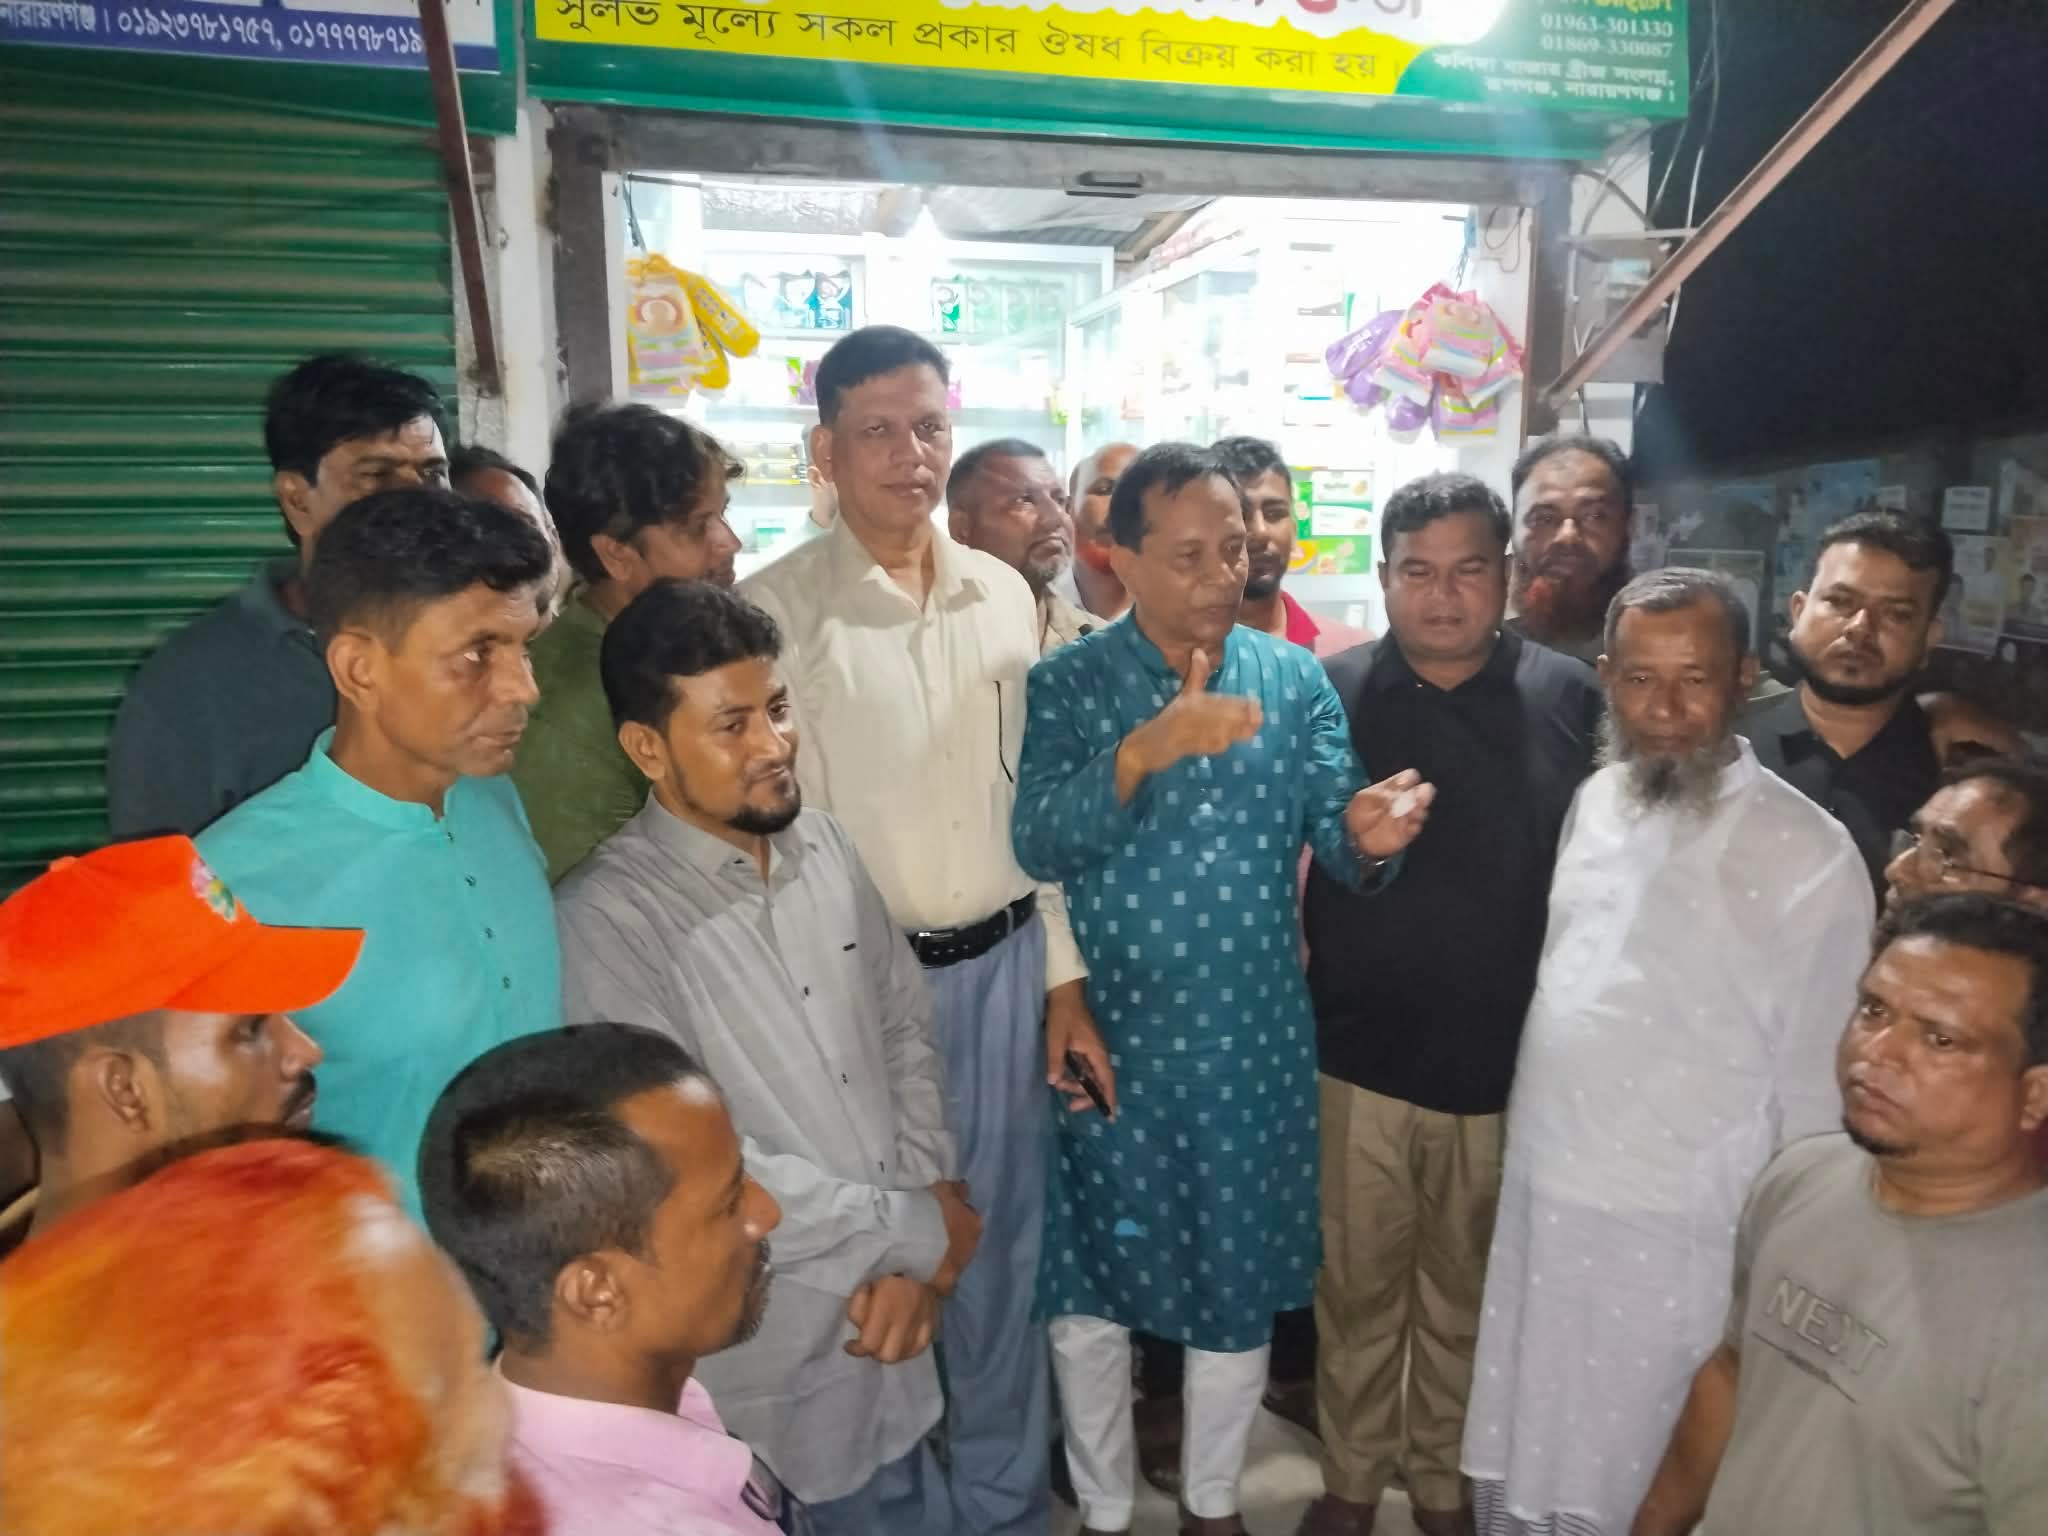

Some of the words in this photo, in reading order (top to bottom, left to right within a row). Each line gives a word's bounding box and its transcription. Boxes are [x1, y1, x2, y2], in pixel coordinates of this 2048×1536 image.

[556, 0, 662, 32] সুলভ
[677, 4, 780, 44] মূল্যে
[795, 13, 898, 46] সকল
[913, 21, 1021, 54] প্রকার
[1039, 20, 1125, 61] ঔষধ
[1137, 28, 1240, 70] বিক্রয়
[1251, 45, 1318, 77] করা
[1328, 52, 1379, 80] হয়
[1762, 1276, 1888, 1376] NEXT
